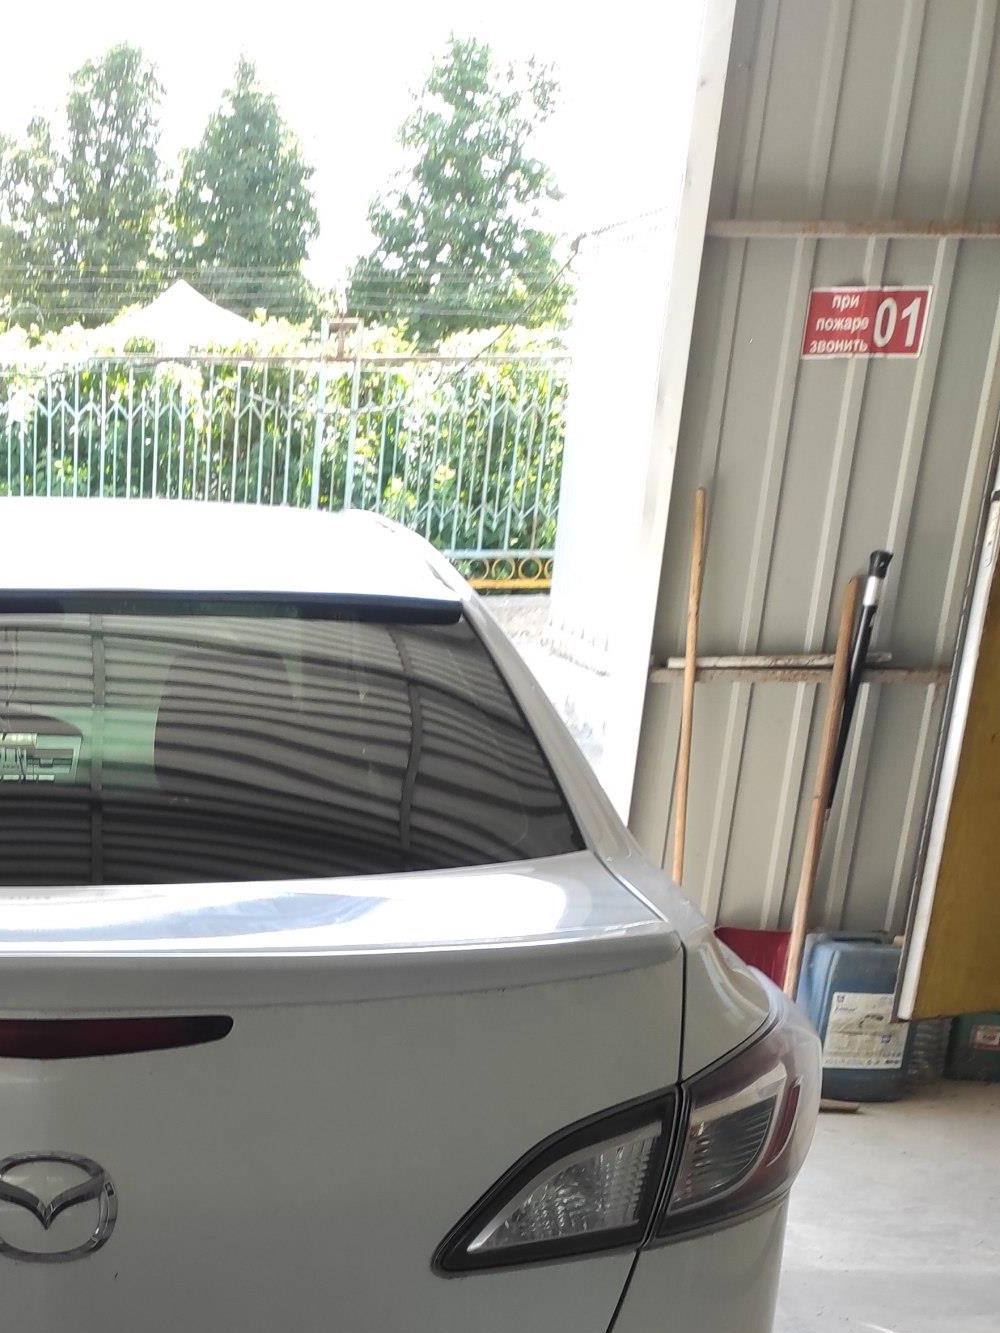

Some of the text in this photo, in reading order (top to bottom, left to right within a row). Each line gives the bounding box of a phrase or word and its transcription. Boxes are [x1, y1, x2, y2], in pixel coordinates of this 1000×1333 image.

[832, 294, 860, 311] при
[816, 316, 869, 334] пожаре
[873, 297, 921, 347] 01
[809, 338, 868, 353] звонить
